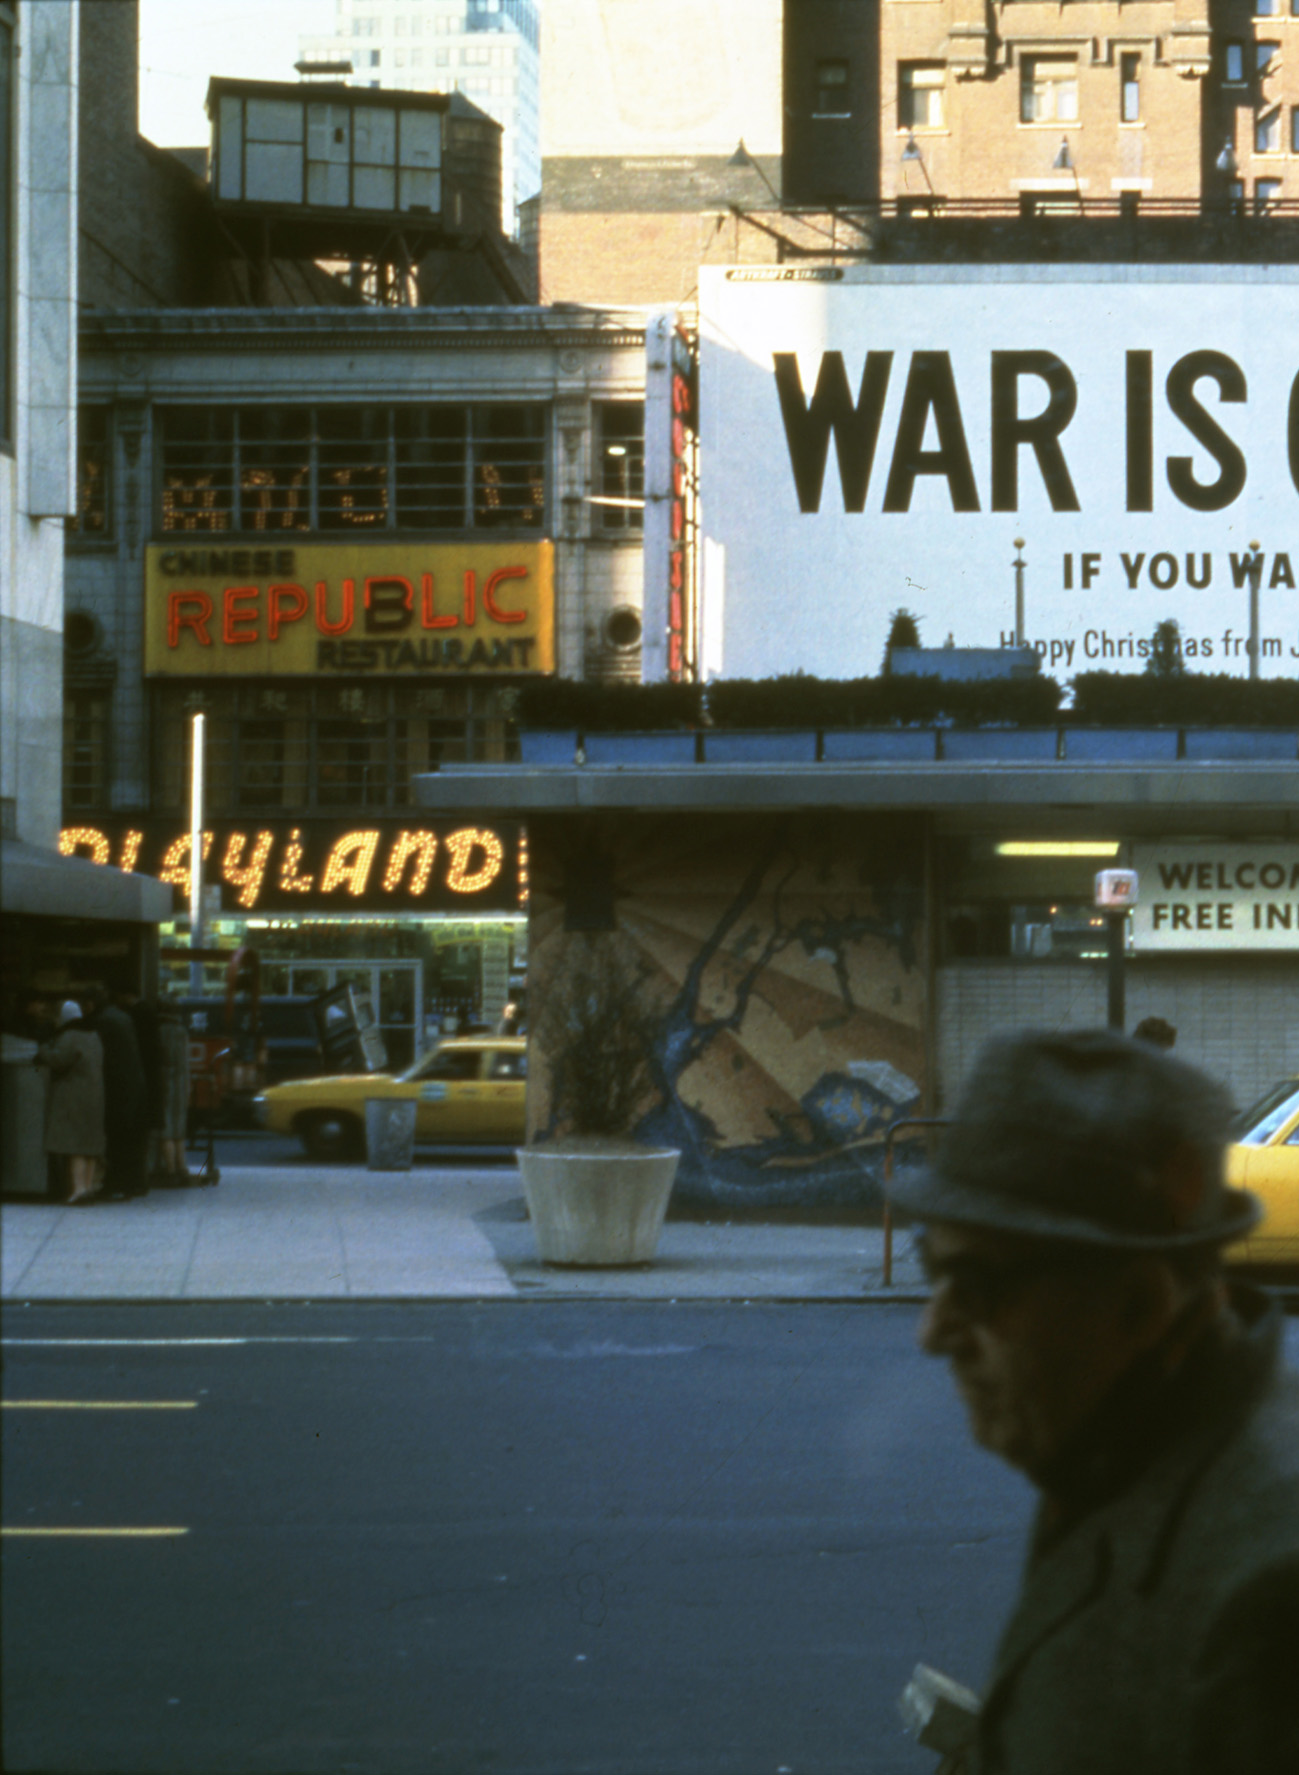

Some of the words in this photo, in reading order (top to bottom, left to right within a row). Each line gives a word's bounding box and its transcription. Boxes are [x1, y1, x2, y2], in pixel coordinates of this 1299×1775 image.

[772, 350, 1082, 513] WAR
[1125, 349, 1248, 512] IS
[158, 549, 296, 578] CHINESE
[1063, 553, 1101, 589] IF
[1120, 552, 1211, 589] YOU
[166, 565, 530, 649] REPUBLIC
[316, 636, 536, 671] RESTAURANT
[1151, 903, 1234, 930] FREE
